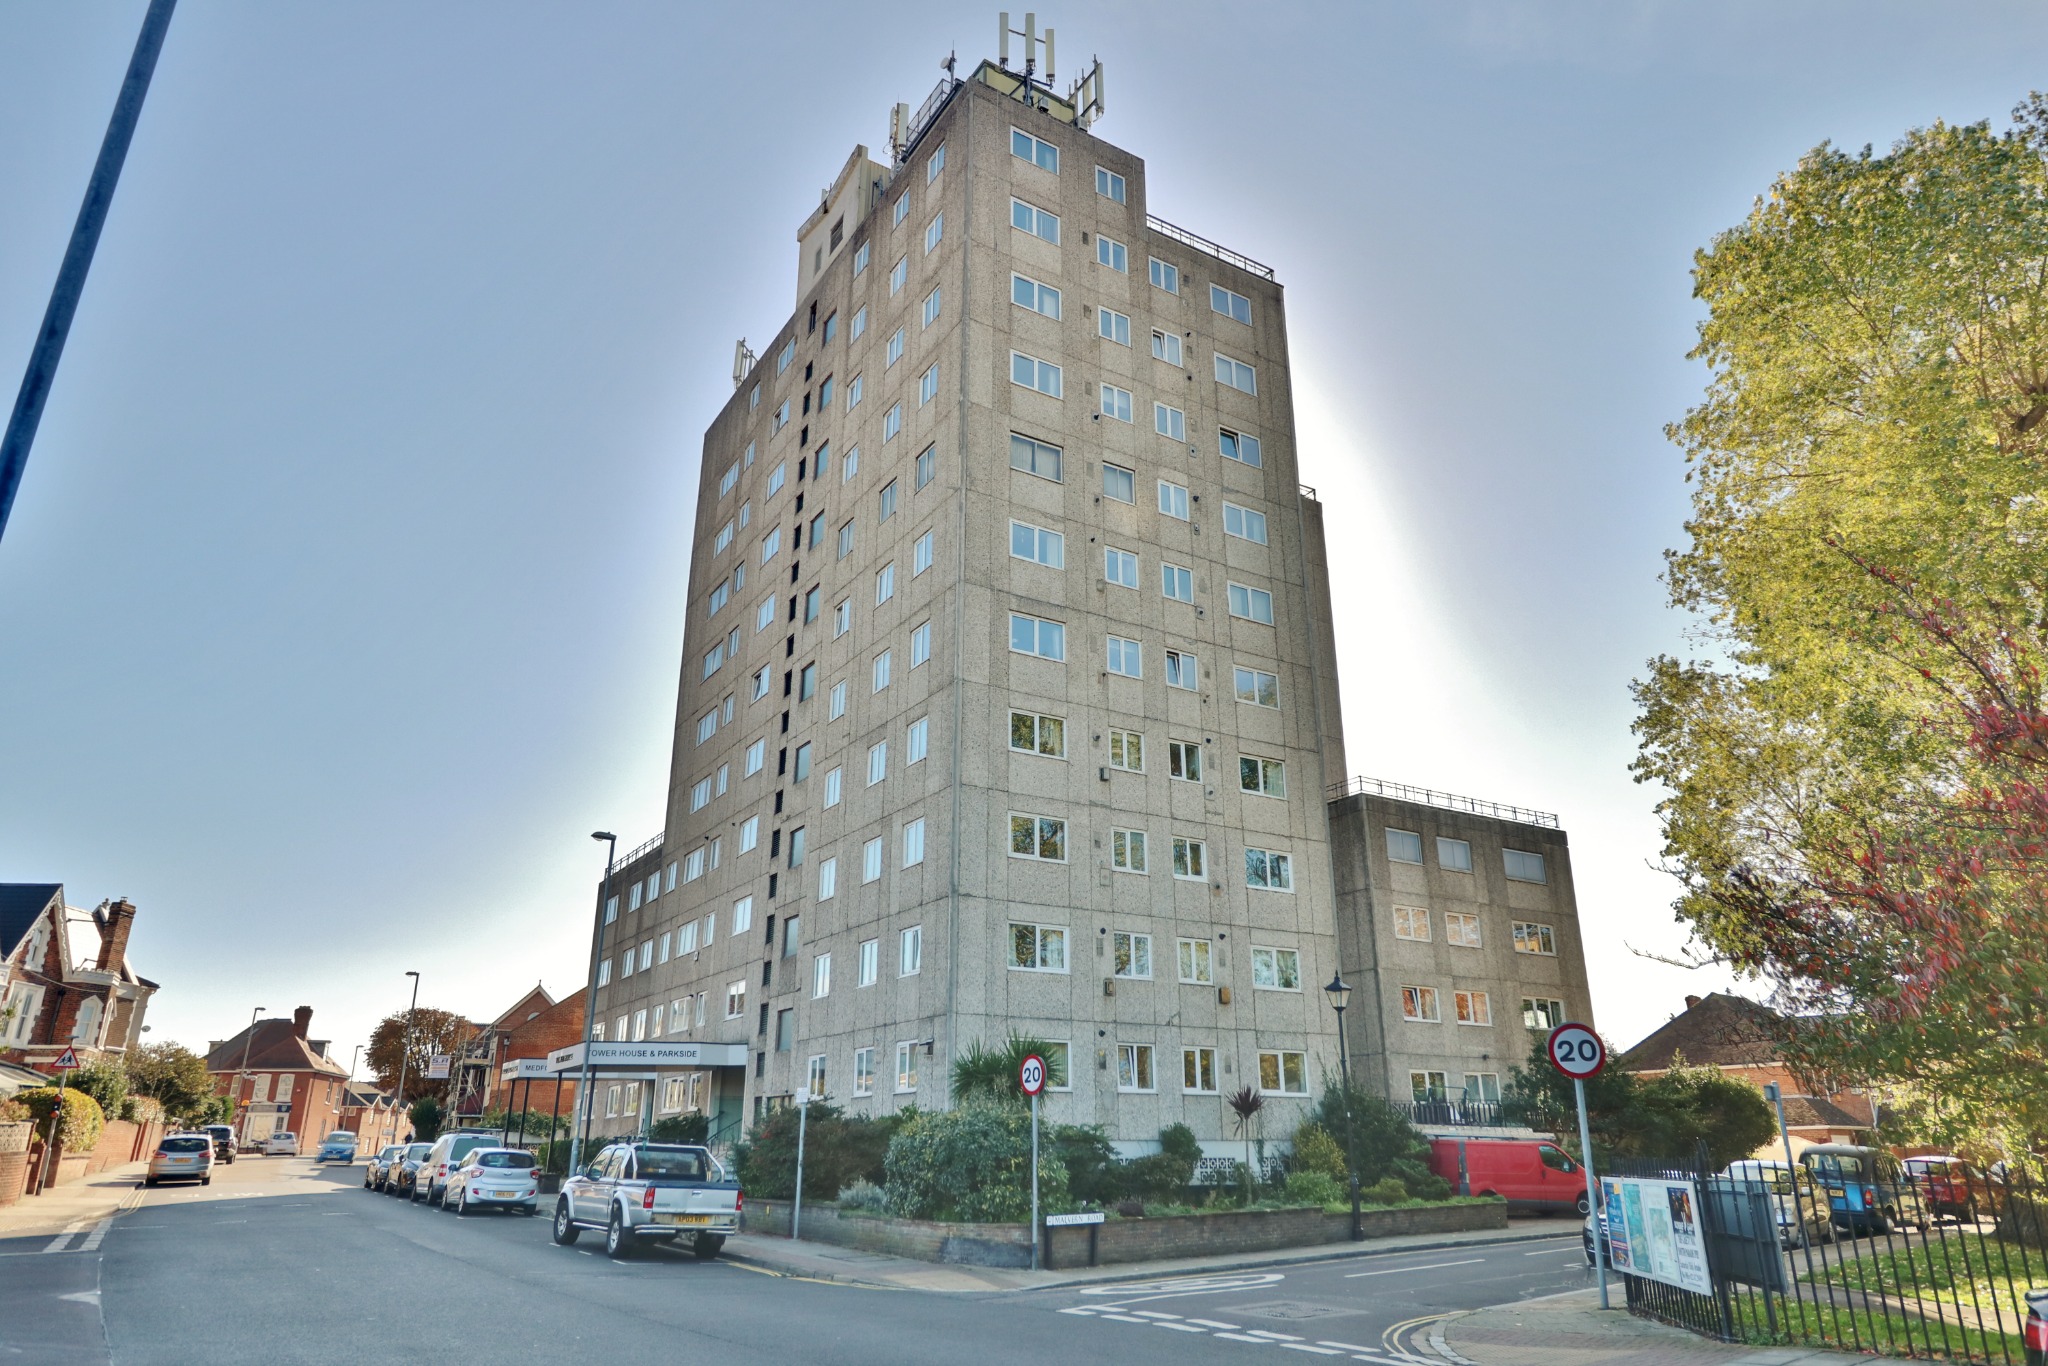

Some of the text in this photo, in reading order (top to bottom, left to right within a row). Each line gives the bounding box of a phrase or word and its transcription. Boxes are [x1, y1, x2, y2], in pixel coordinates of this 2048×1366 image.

[1557, 1039, 1597, 1062] 20
[1024, 1066, 1041, 1084] 20
[1055, 1215, 1083, 1224] MALVERN
[1088, 1214, 1104, 1222] ROAD
